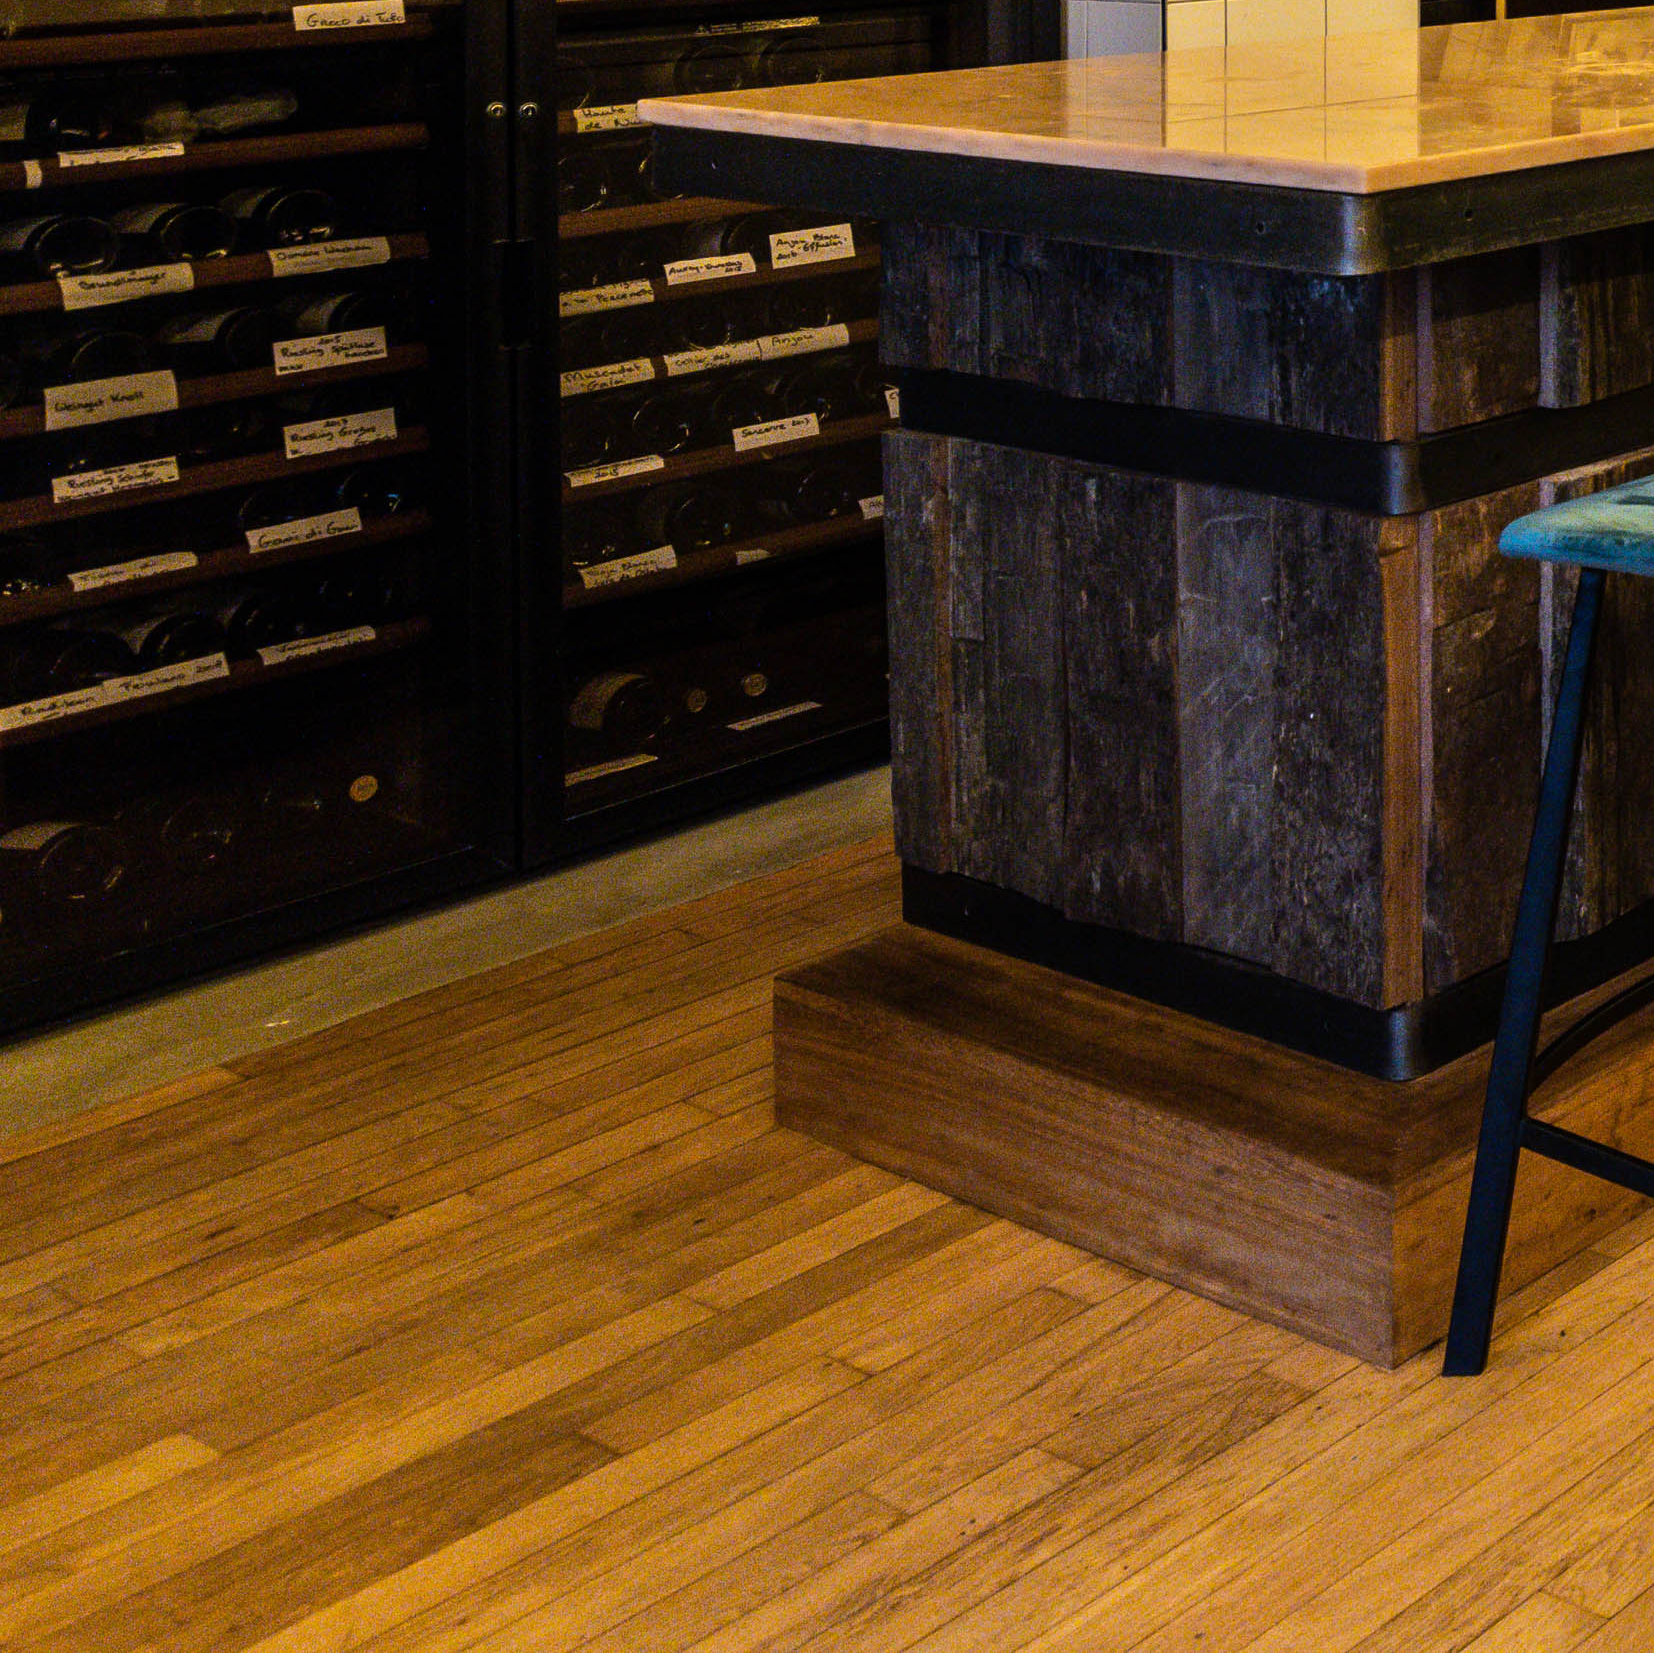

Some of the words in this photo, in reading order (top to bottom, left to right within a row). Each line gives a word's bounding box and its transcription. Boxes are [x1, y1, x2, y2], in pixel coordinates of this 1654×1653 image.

[306, 12, 350, 28] Greco
[772, 334, 814, 347] Anjou
[563, 362, 642, 383] Muscadet
